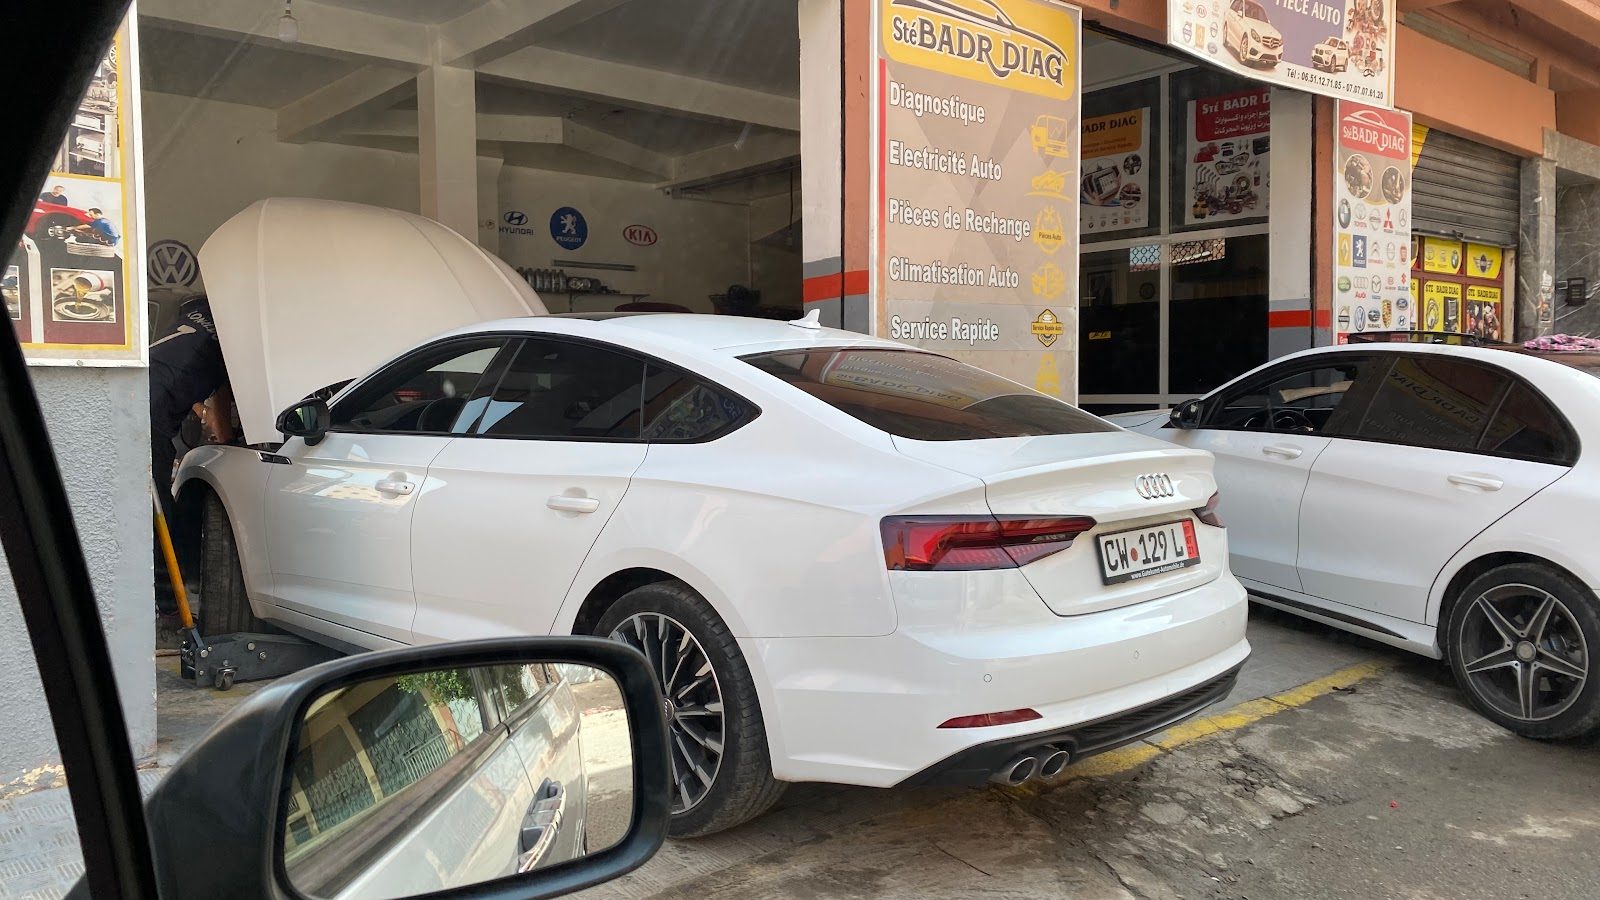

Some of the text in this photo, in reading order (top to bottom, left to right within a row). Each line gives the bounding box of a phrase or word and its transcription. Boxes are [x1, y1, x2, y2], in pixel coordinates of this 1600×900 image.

[1311, 2, 1341, 25] AUTO
[892, 16, 1063, 86] Sté BADR DIAG
[1287, 68, 1296, 79] Tél
[1301, 71, 1342, 89] 06.51.12.71.85
[890, 81, 985, 126] Diagnostique
[1223, 95, 1258, 110] BADR
[1082, 115, 1137, 135] ADR DIAG
[1352, 126, 1384, 152] BADR
[1381, 133, 1405, 153] DIAG
[889, 140, 1002, 181] Electricité Auto
[499, 227, 534, 236] HYUNDAI
[889, 198, 1031, 242] Pièces de Rechange
[556, 235, 582, 243] PEUGEOT
[628, 229, 652, 243] KIA
[889, 256, 1019, 288] Climatisation Auto
[891, 315, 999, 346] Service Rapide
[1104, 537, 1129, 571] CW
[1139, 530, 1167, 565] 129
[1171, 528, 1184, 557] L
